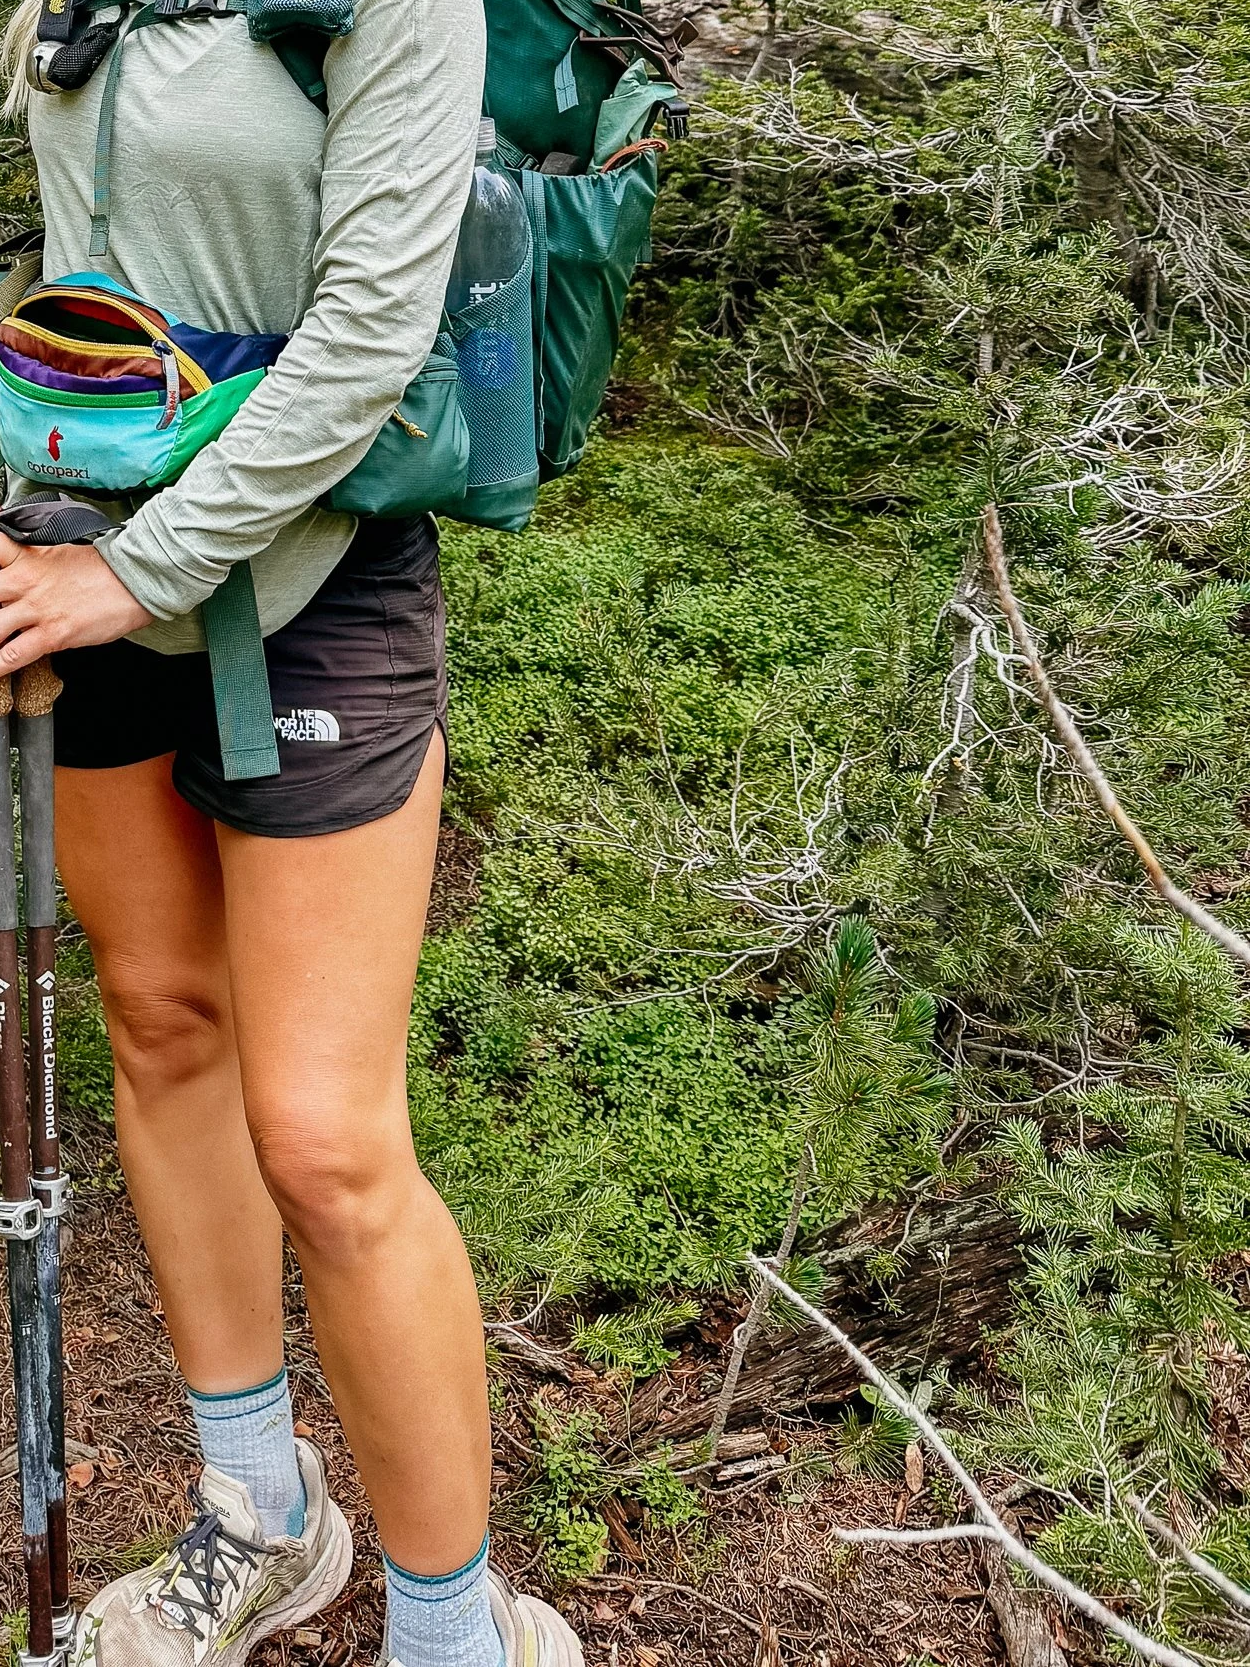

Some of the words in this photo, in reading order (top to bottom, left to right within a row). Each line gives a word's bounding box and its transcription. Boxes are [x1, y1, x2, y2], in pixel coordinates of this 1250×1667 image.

[27, 460, 91, 480] cotopaxi
[291, 708, 316, 719] THE
[273, 717, 316, 731] NORTH
[281, 728, 316, 741] FACE
[42, 995, 55, 1051] Black
[43, 1052, 58, 1140] Diamond
